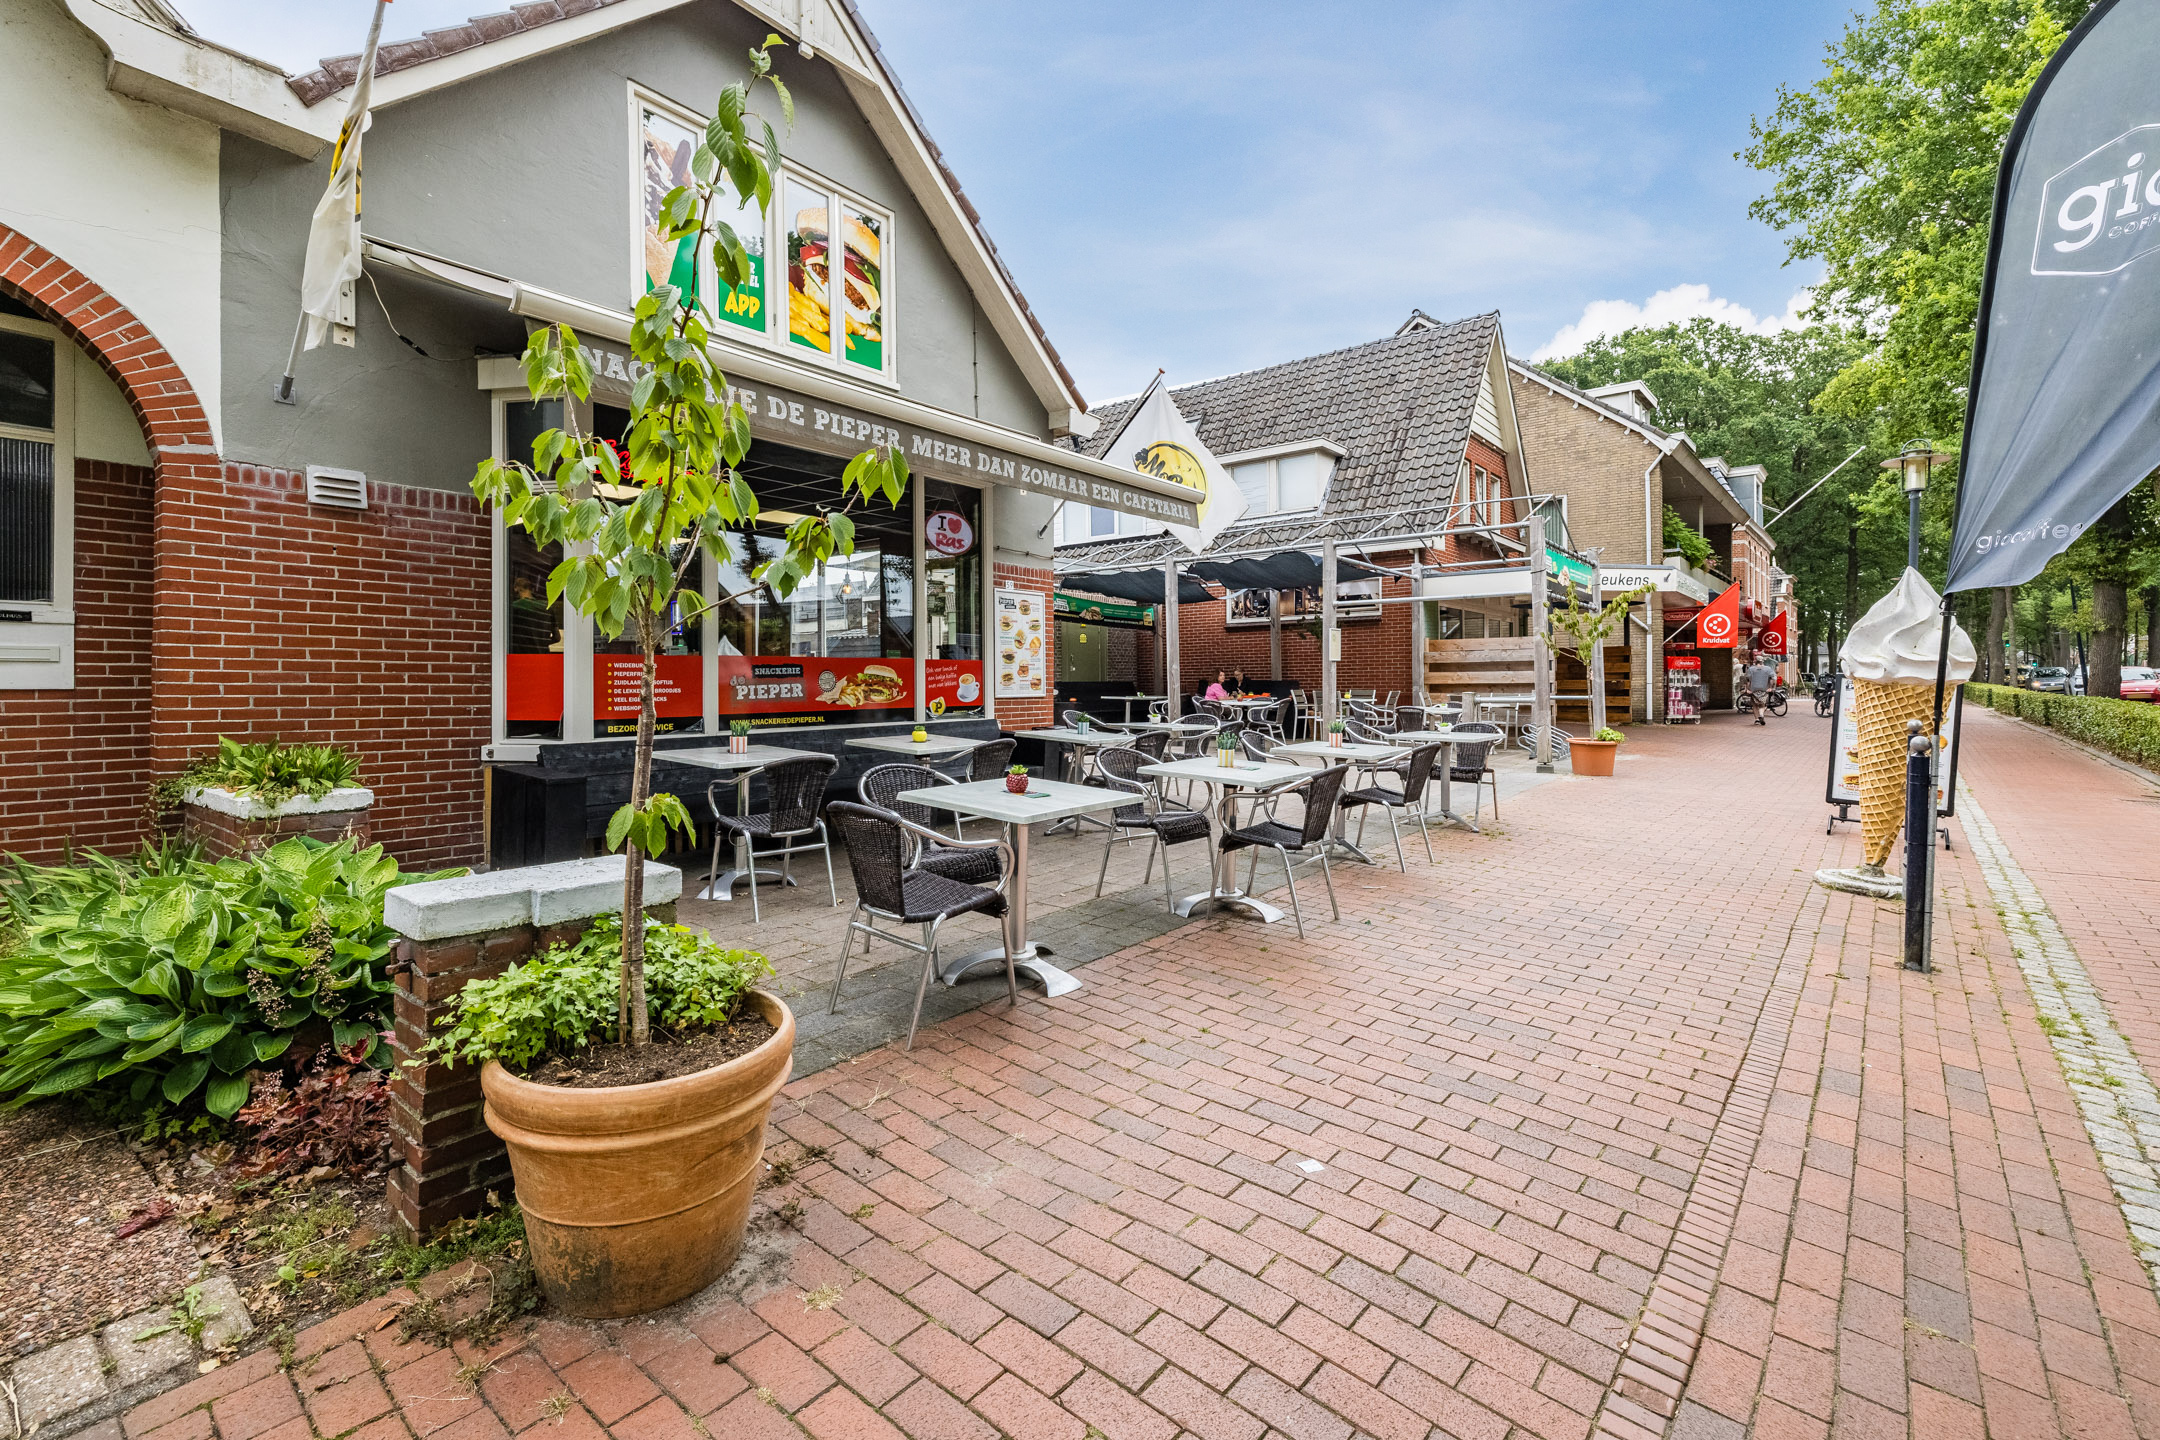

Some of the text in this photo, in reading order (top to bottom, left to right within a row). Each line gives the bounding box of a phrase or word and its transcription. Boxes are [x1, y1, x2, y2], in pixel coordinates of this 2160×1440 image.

[2108, 211, 2160, 239] COFF
[724, 291, 760, 318] APP
[578, 344, 757, 414] NACIE
[767, 395, 804, 426] DE
[911, 434, 972, 468] MEER
[977, 452, 1016, 479] DAN
[1021, 464, 1088, 497] ZOMAAR
[1091, 483, 1120, 504] EEN
[1123, 491, 1191, 520] CAFETARIA
[937, 515, 947, 532] I
[935, 532, 965, 550] Ras
[1600, 573, 1650, 586] eukens
[1702, 636, 1730, 644] Kruidvat
[754, 666, 801, 675] SNACKERIE
[735, 683, 804, 700] PIEPER
[607, 723, 674, 733] BEZORVICE
